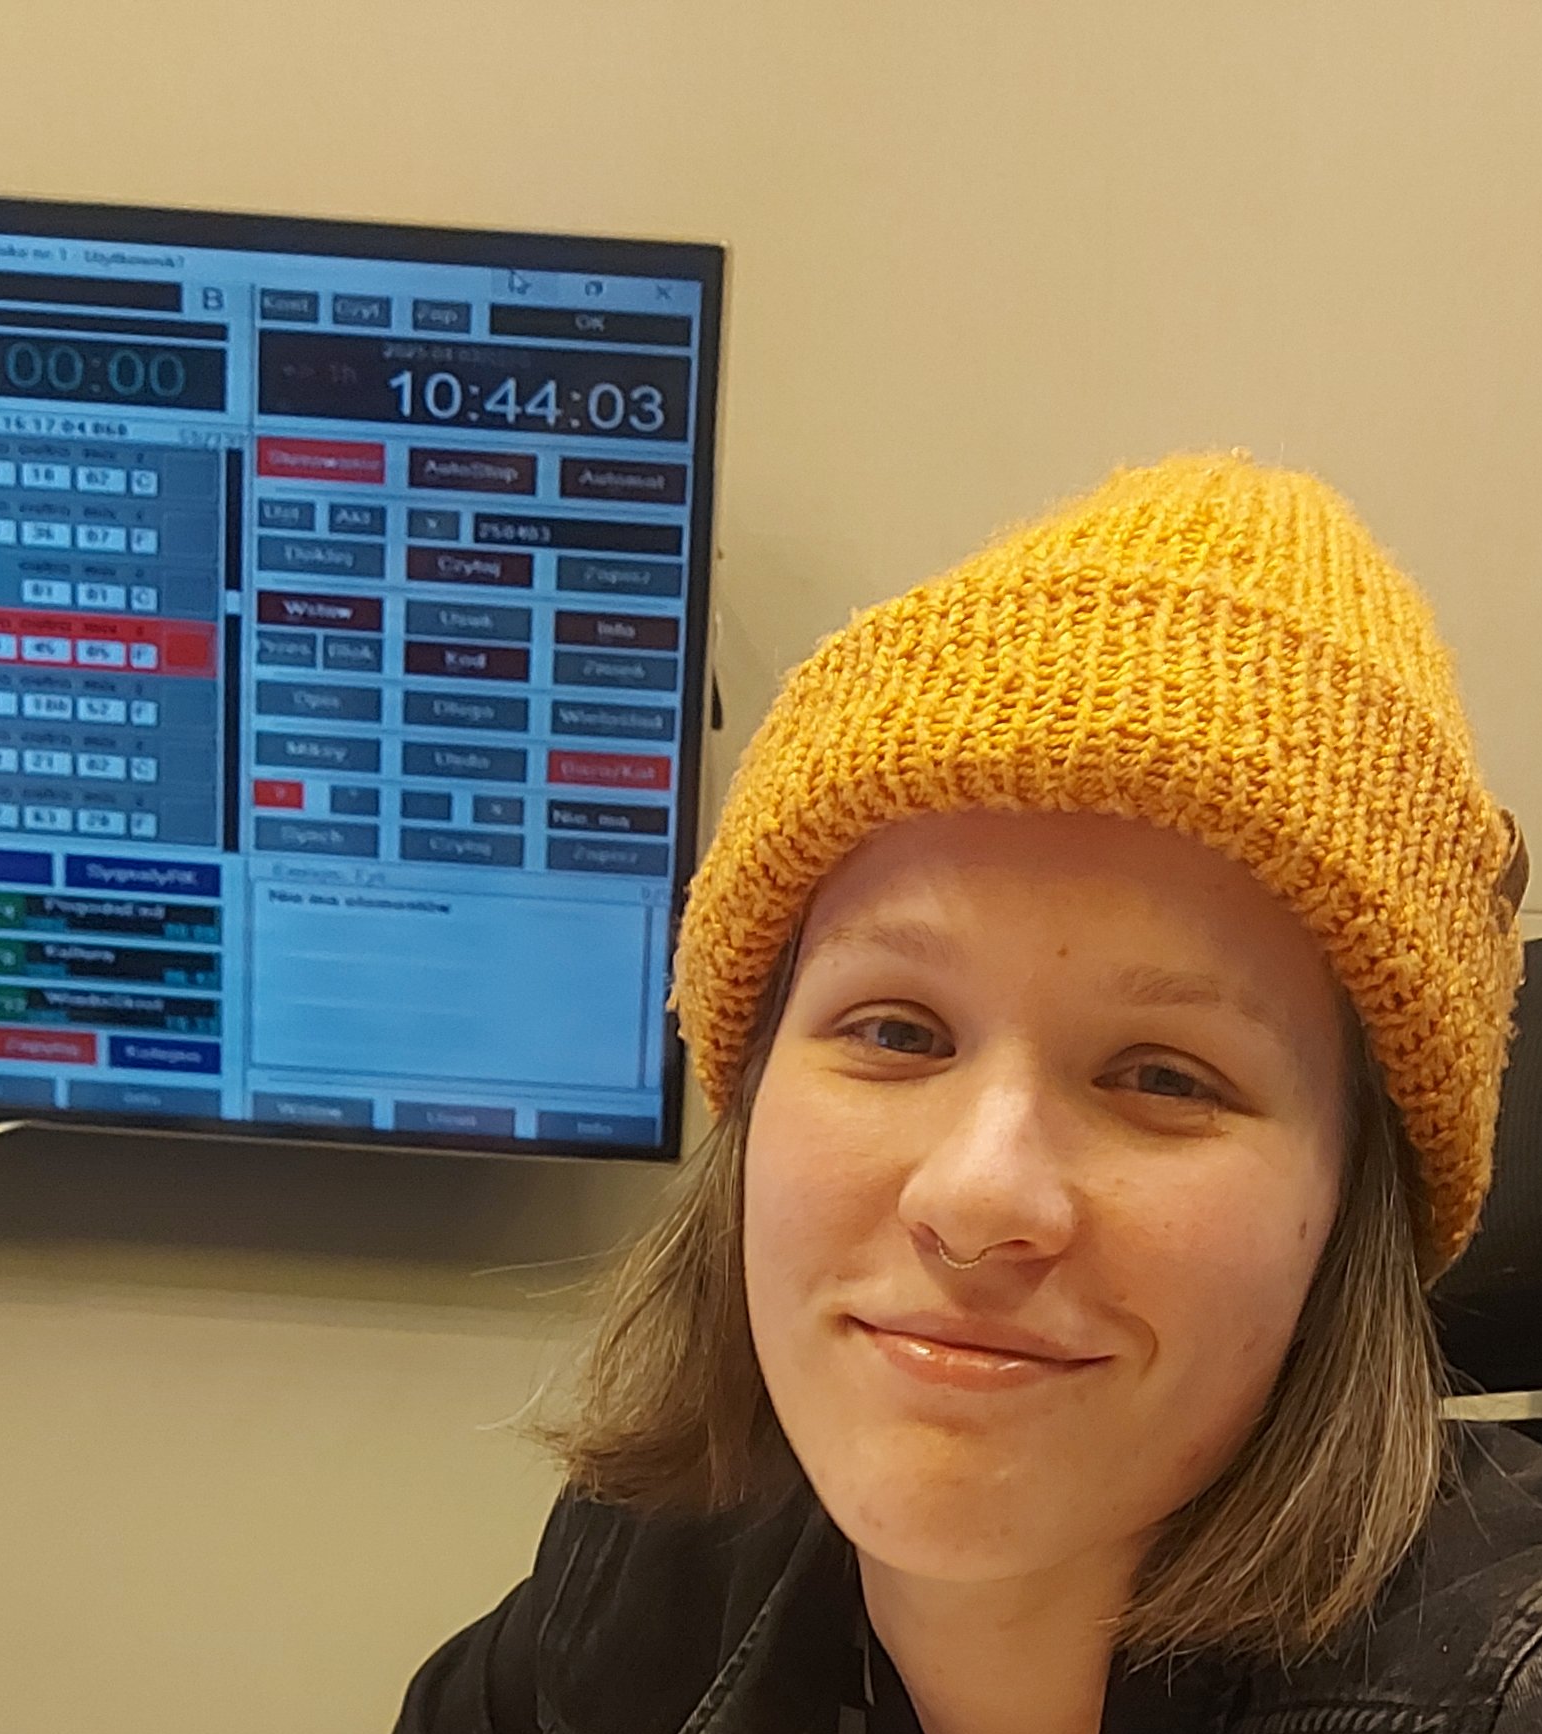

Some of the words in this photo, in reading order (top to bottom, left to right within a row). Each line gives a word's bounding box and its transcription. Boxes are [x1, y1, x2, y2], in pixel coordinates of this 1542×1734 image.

[202, 287, 224, 311] B
[6, 342, 186, 398] 00:00
[389, 369, 665, 432] 10:44:03
